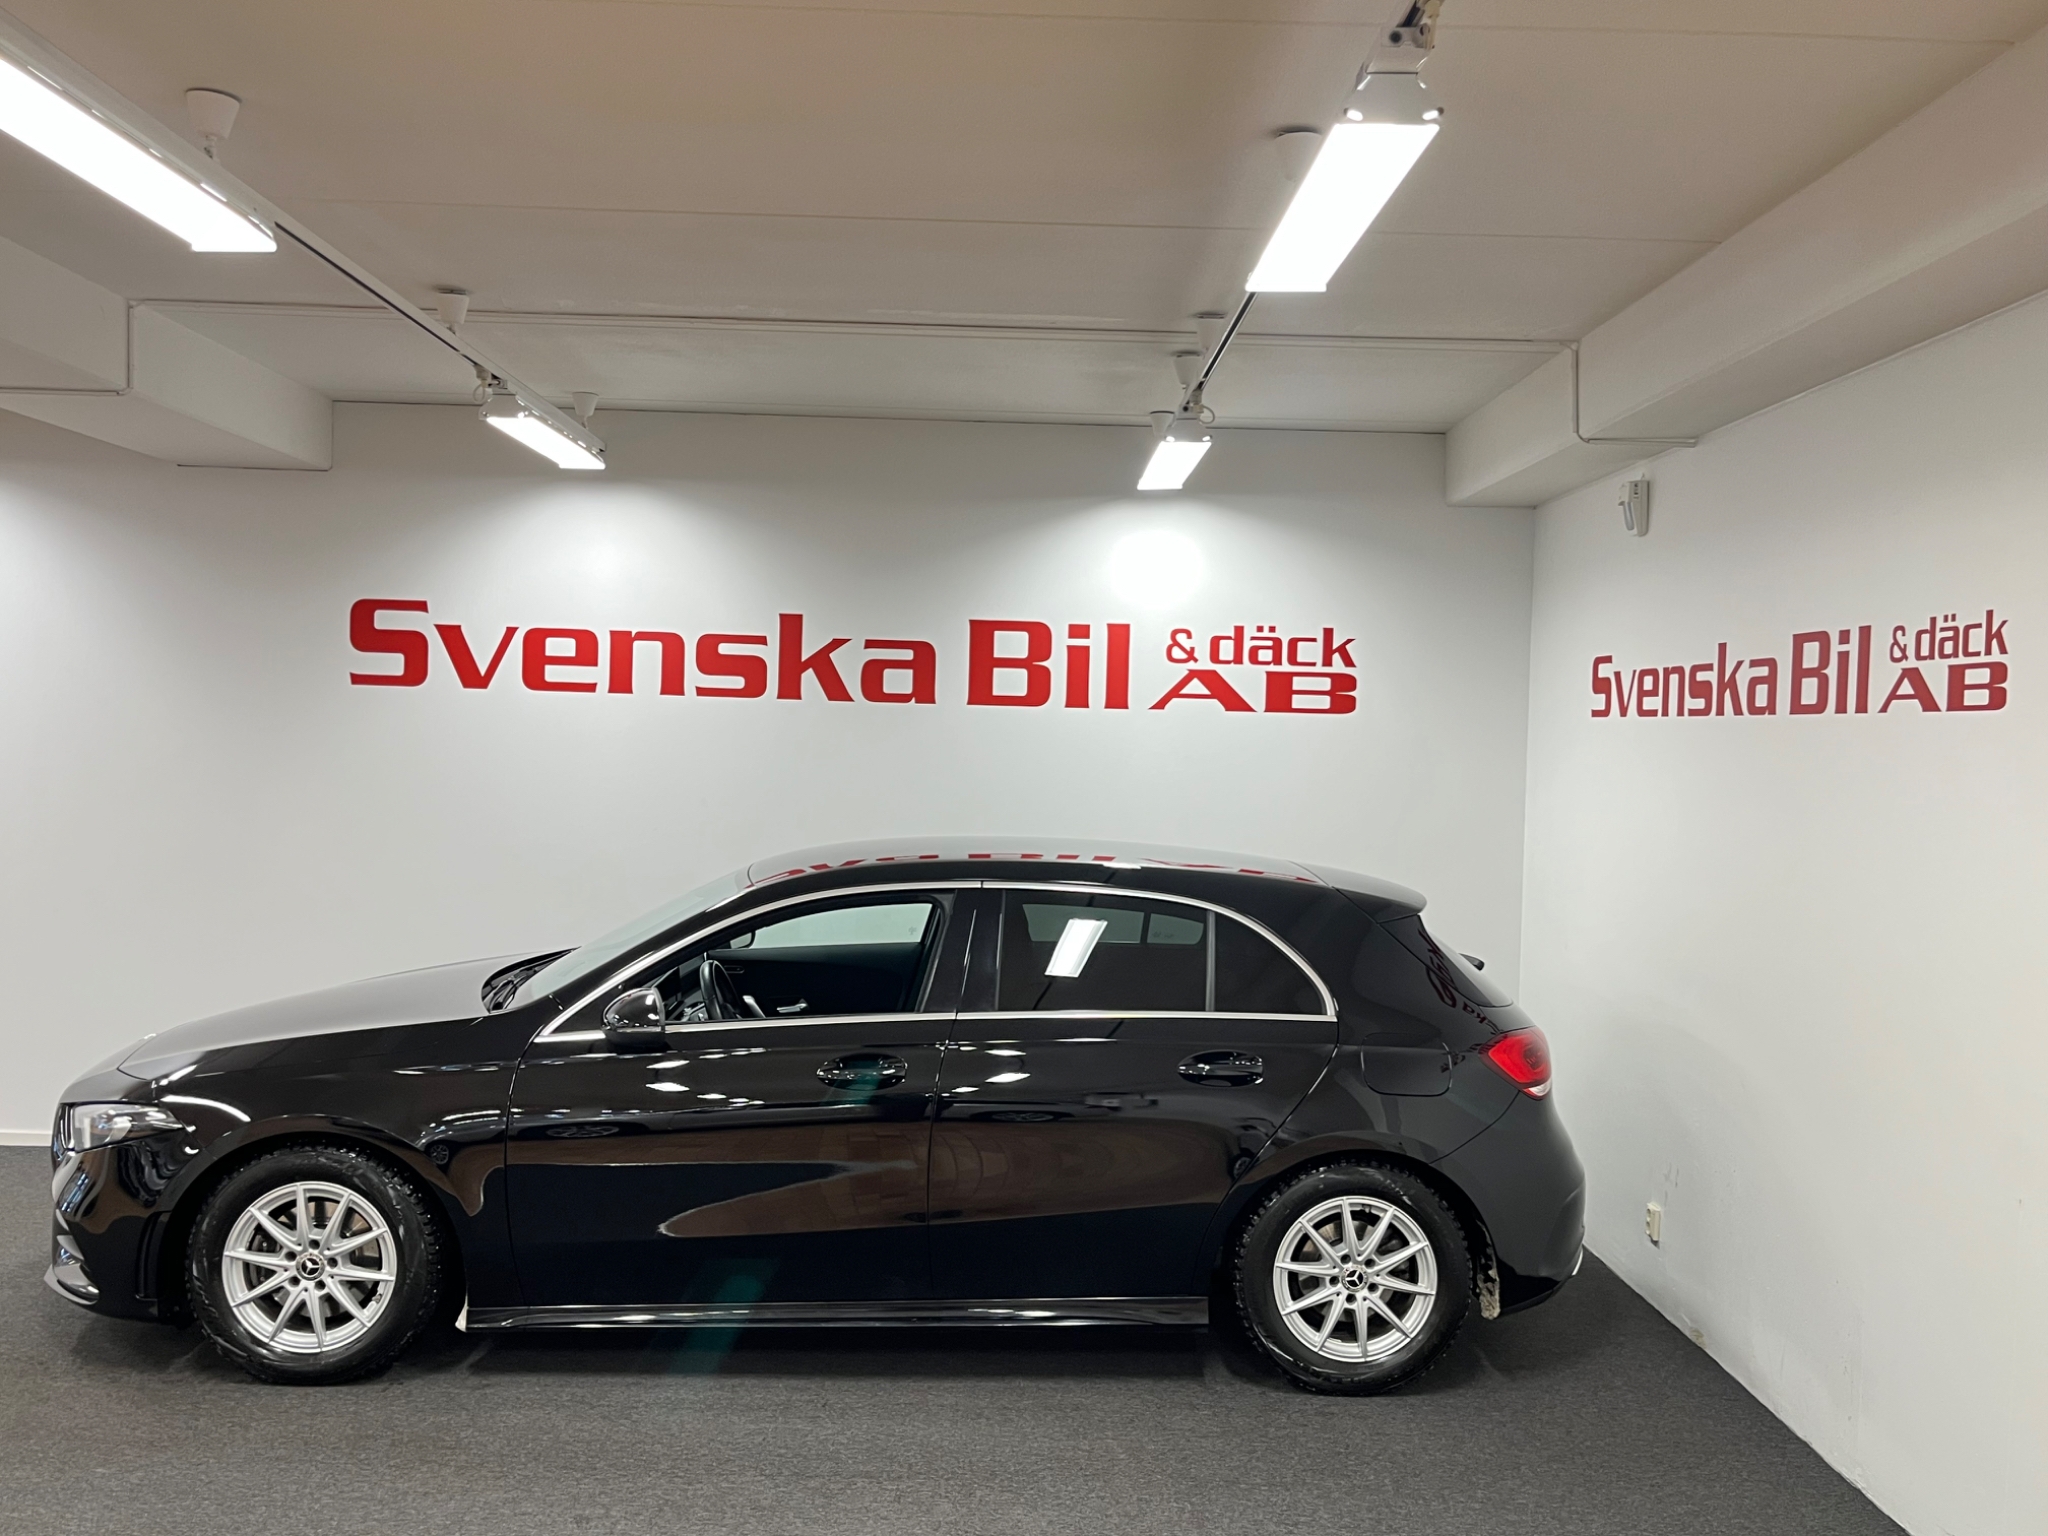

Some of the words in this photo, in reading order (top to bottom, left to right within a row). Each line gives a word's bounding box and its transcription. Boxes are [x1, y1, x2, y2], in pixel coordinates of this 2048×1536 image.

[349, 598, 937, 704] Svenska
[967, 619, 1131, 710] Bil
[1166, 627, 1199, 665] &
[1210, 625, 1358, 667] däck
[1890, 625, 1908, 663] &
[1915, 610, 2009, 661] däck
[1150, 668, 1358, 715] AB
[1591, 643, 1778, 717] Svenska
[1789, 625, 1872, 715] Bil
[1878, 662, 2008, 712] AB
